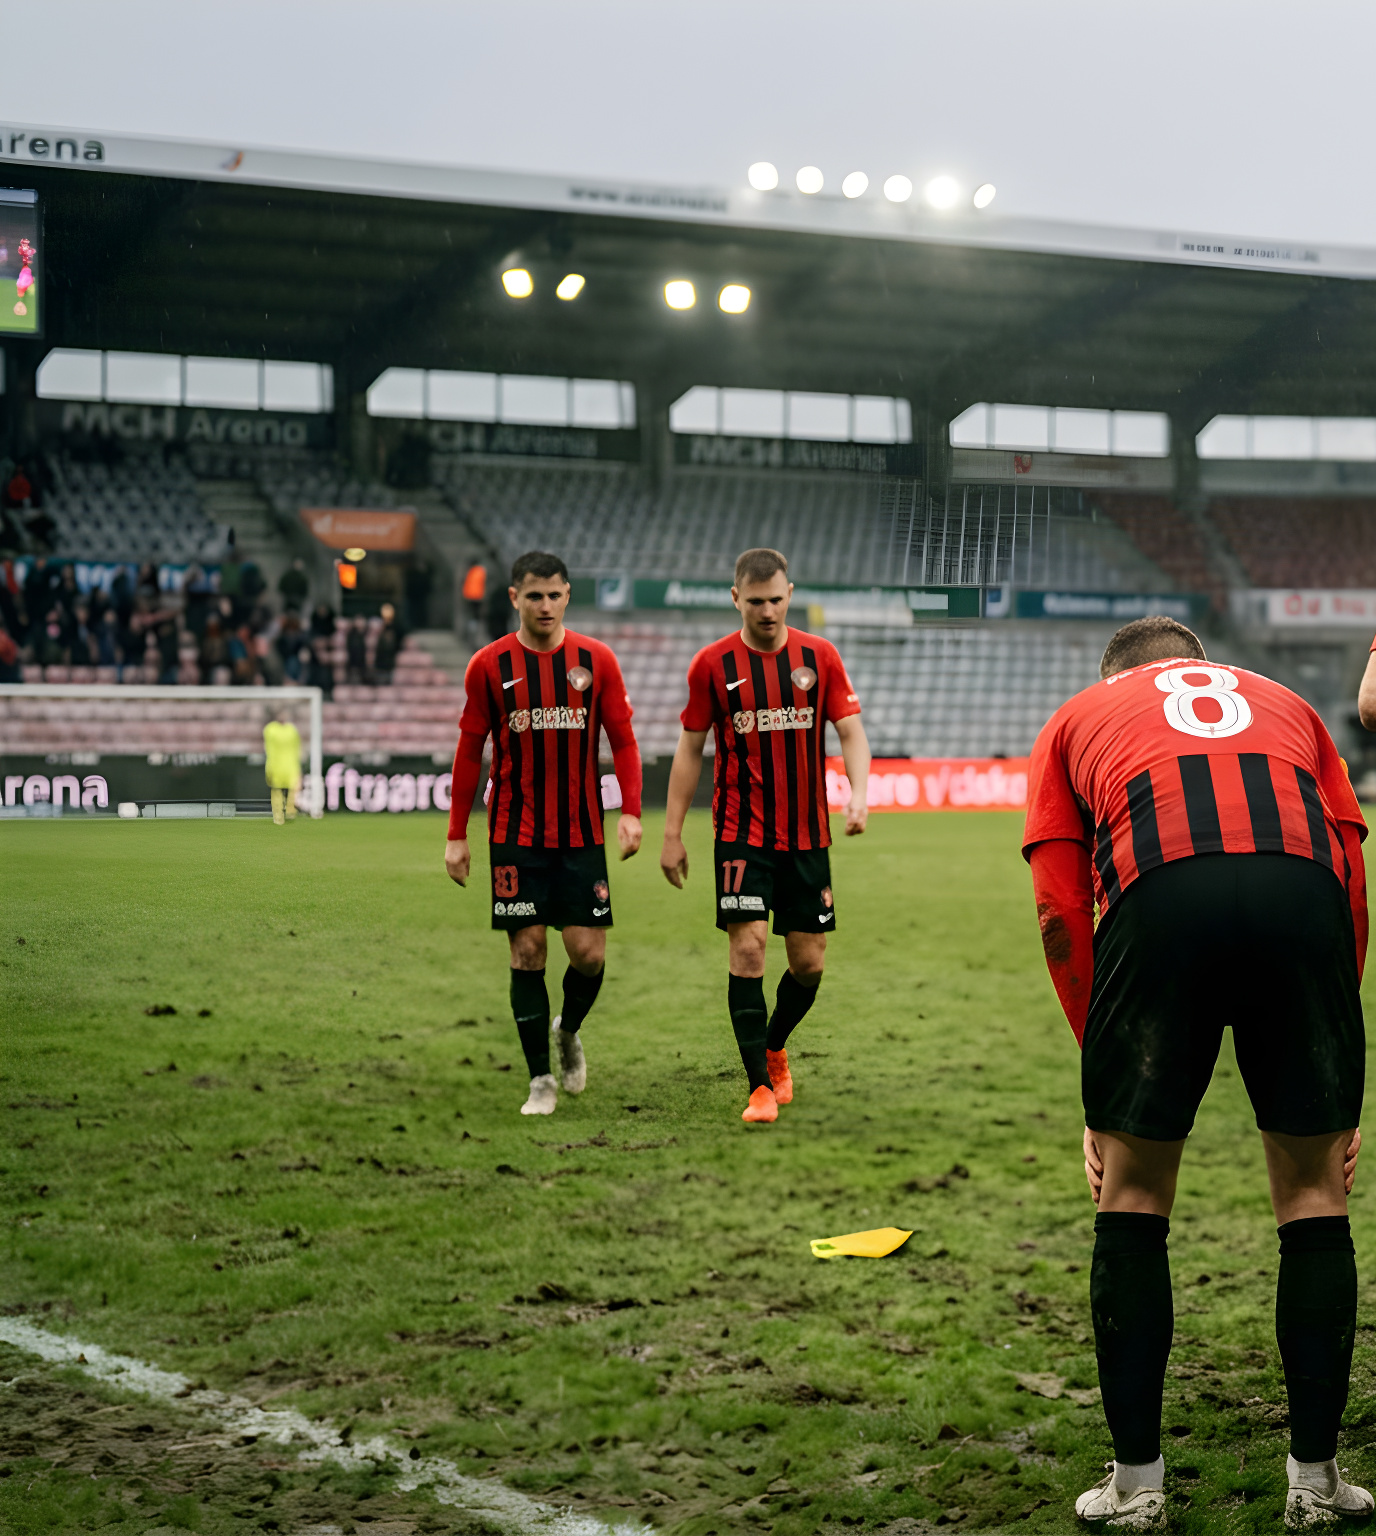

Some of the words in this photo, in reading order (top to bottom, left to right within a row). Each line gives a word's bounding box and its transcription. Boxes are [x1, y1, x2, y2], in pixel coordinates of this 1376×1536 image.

[0, 132, 105, 162] rena
[1154, 666, 1253, 738] 8
[1, 774, 109, 808] rena
[722, 859, 747, 893] 17
